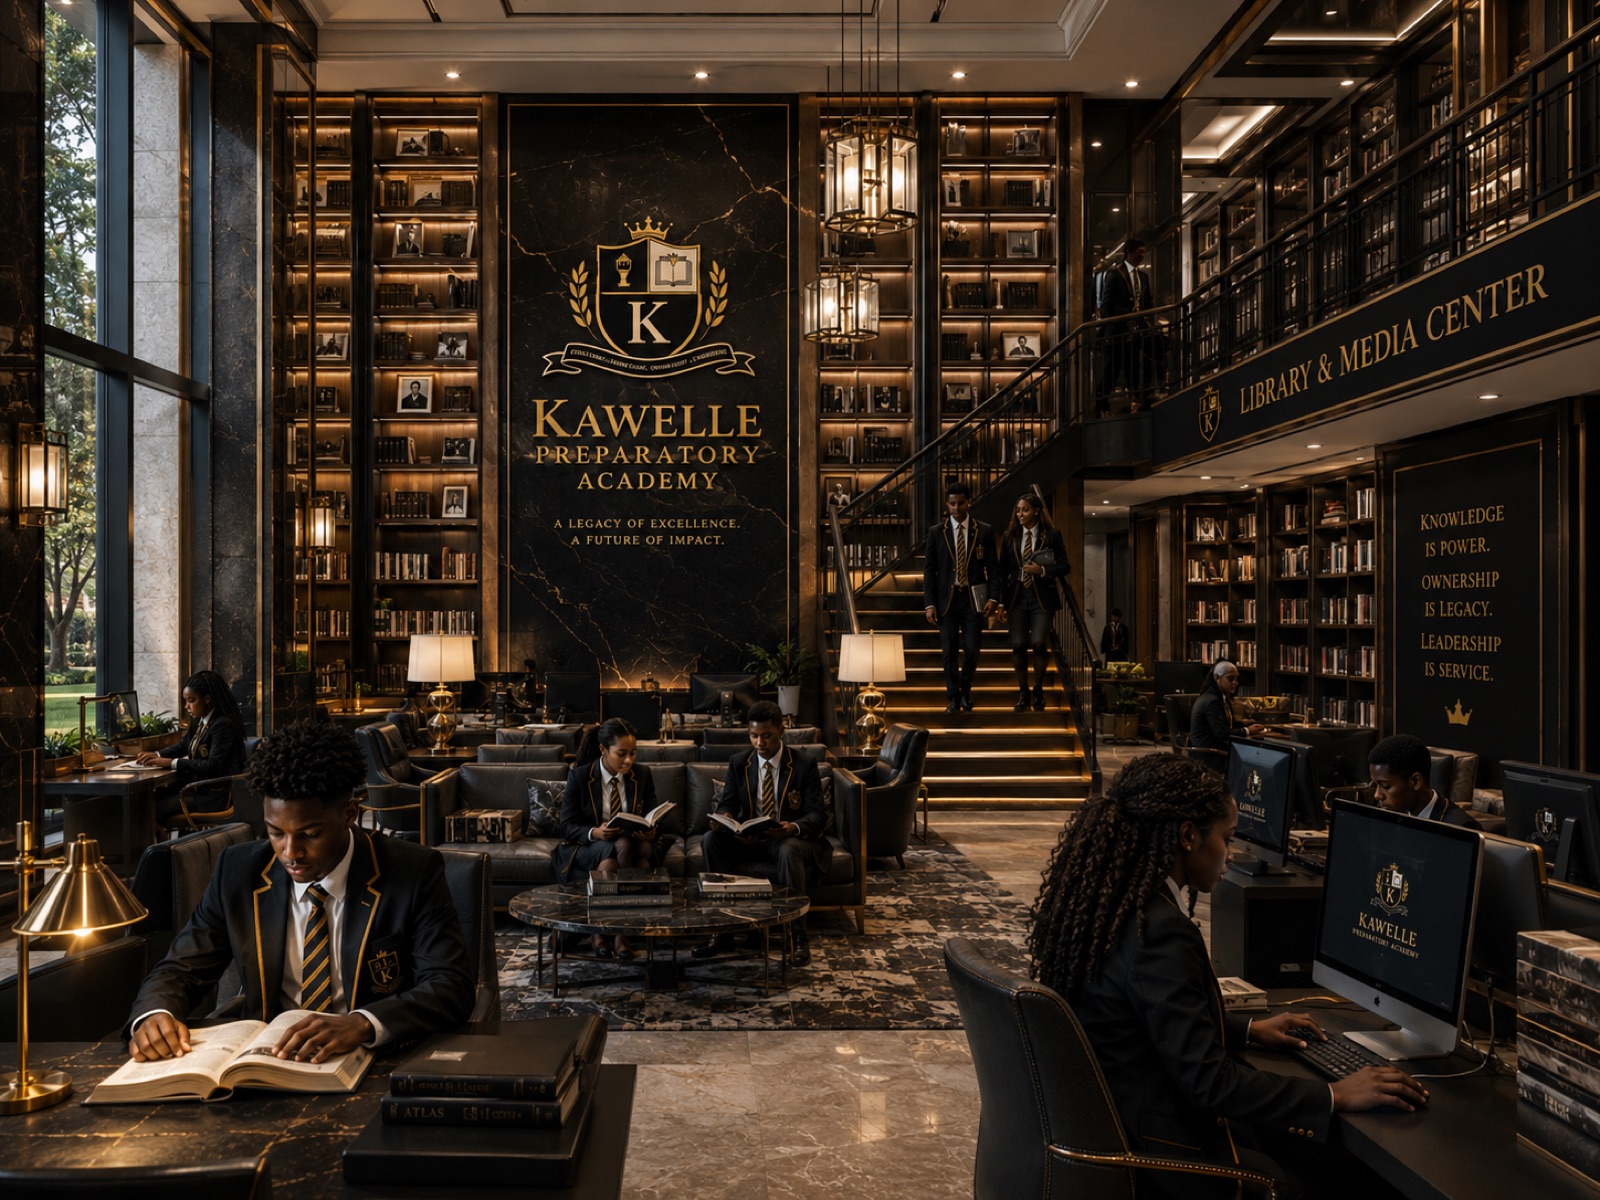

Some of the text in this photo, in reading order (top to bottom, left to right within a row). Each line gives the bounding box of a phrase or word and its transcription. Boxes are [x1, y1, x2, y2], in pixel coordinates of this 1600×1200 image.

[627, 301, 671, 344] K
[1240, 264, 1549, 414] LIBRARY & MEDIA CENTER
[532, 399, 762, 438] KAWELLE
[1204, 413, 1214, 433] K
[535, 446, 760, 464] PREPARATORY
[577, 472, 718, 490] ACADEMY
[554, 518, 741, 529] A LEGACY OF EXCELLENCE.
[1420, 505, 1504, 531] KNOWLEDGE
[571, 535, 725, 546] A FUTURE OF IMPACT.
[1425, 537, 1490, 558] IS POWER.
[1421, 571, 1500, 590] OWNERSHIP
[1424, 601, 1493, 617] IS LEGACY.
[1421, 633, 1502, 652] LEADERSHIP
[1424, 662, 1494, 682] IS SERVICE.
[1386, 887, 1394, 903] K
[1358, 911, 1418, 947] KAWELLE
[381, 968, 393, 983] K
[403, 1107, 445, 1119] ATLAS
